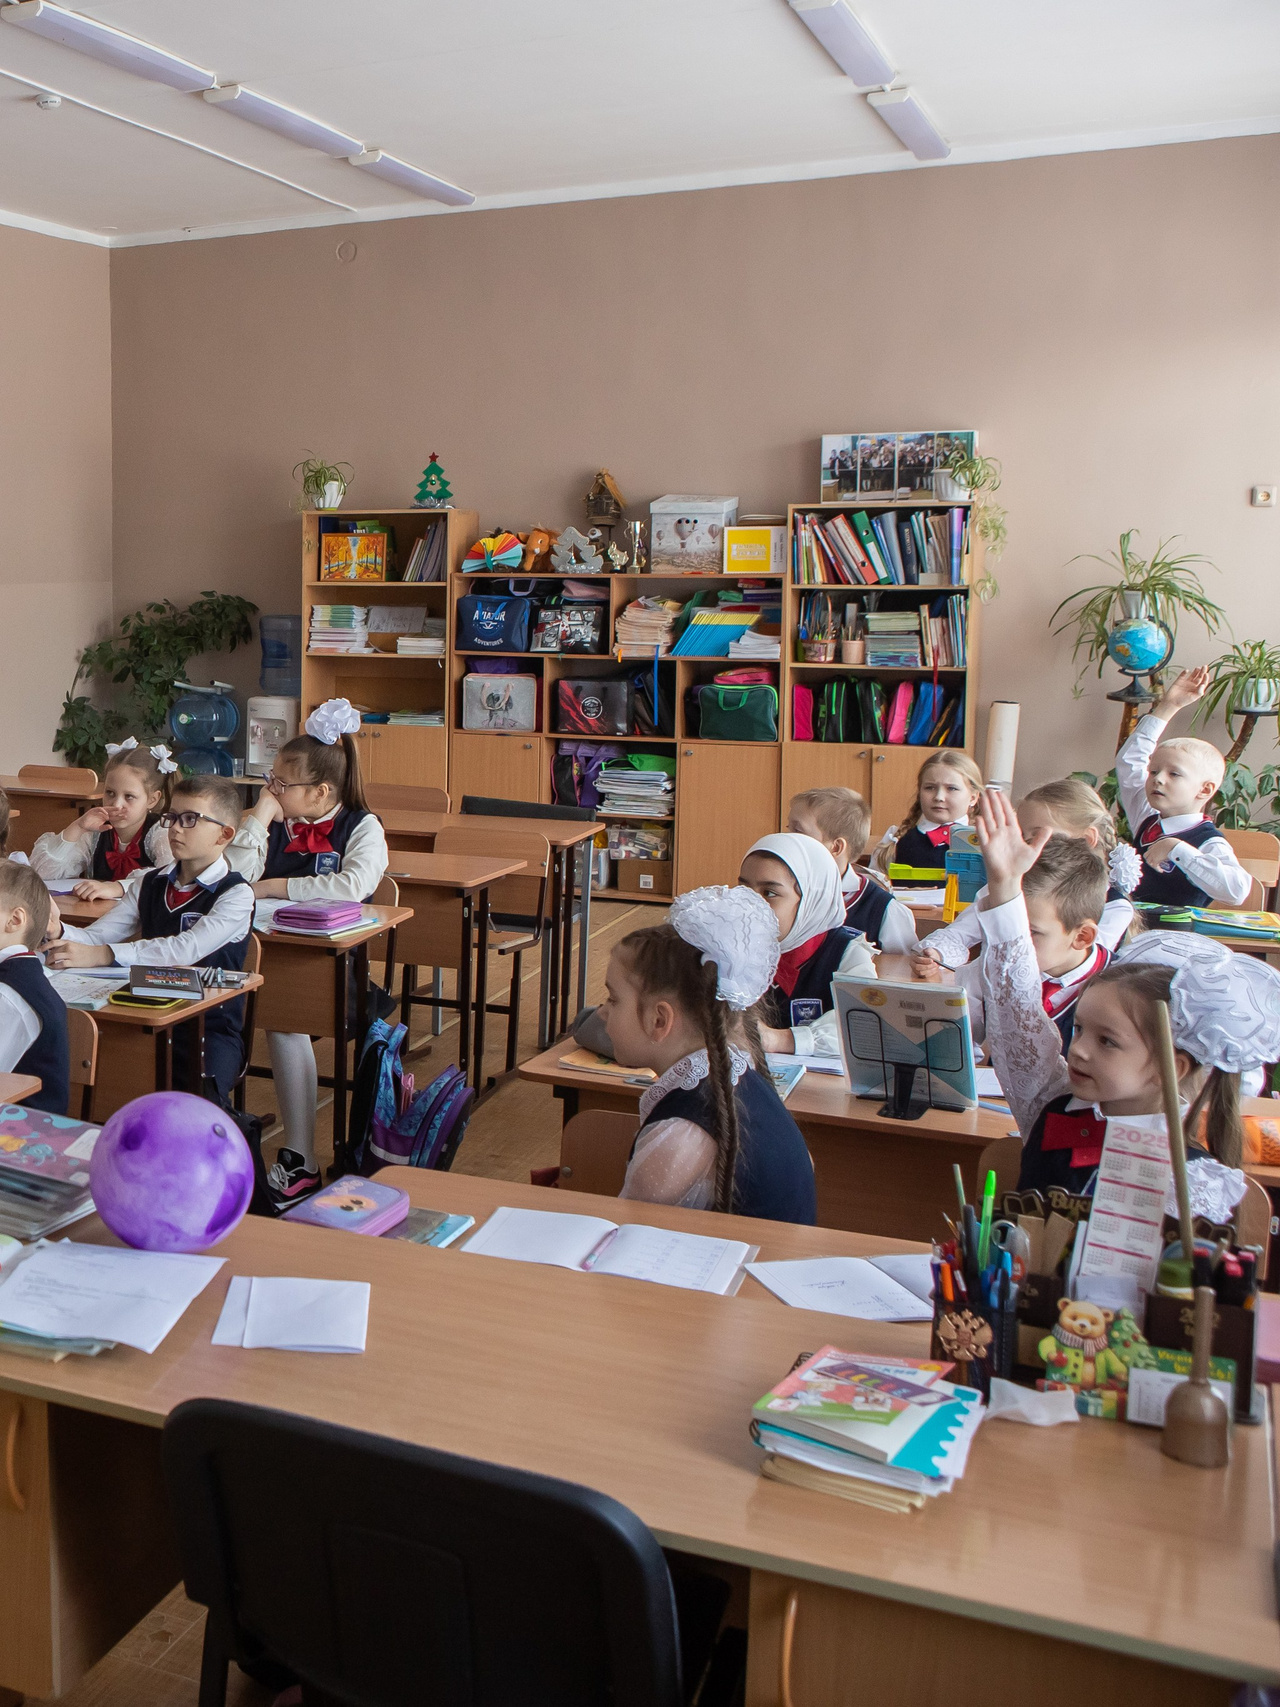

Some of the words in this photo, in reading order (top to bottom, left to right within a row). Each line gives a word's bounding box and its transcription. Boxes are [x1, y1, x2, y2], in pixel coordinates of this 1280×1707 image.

[473, 610, 506, 621] AIAOR
[474, 637, 504, 646] ADVENTURES
[1111, 1127, 1169, 1149] 2025
